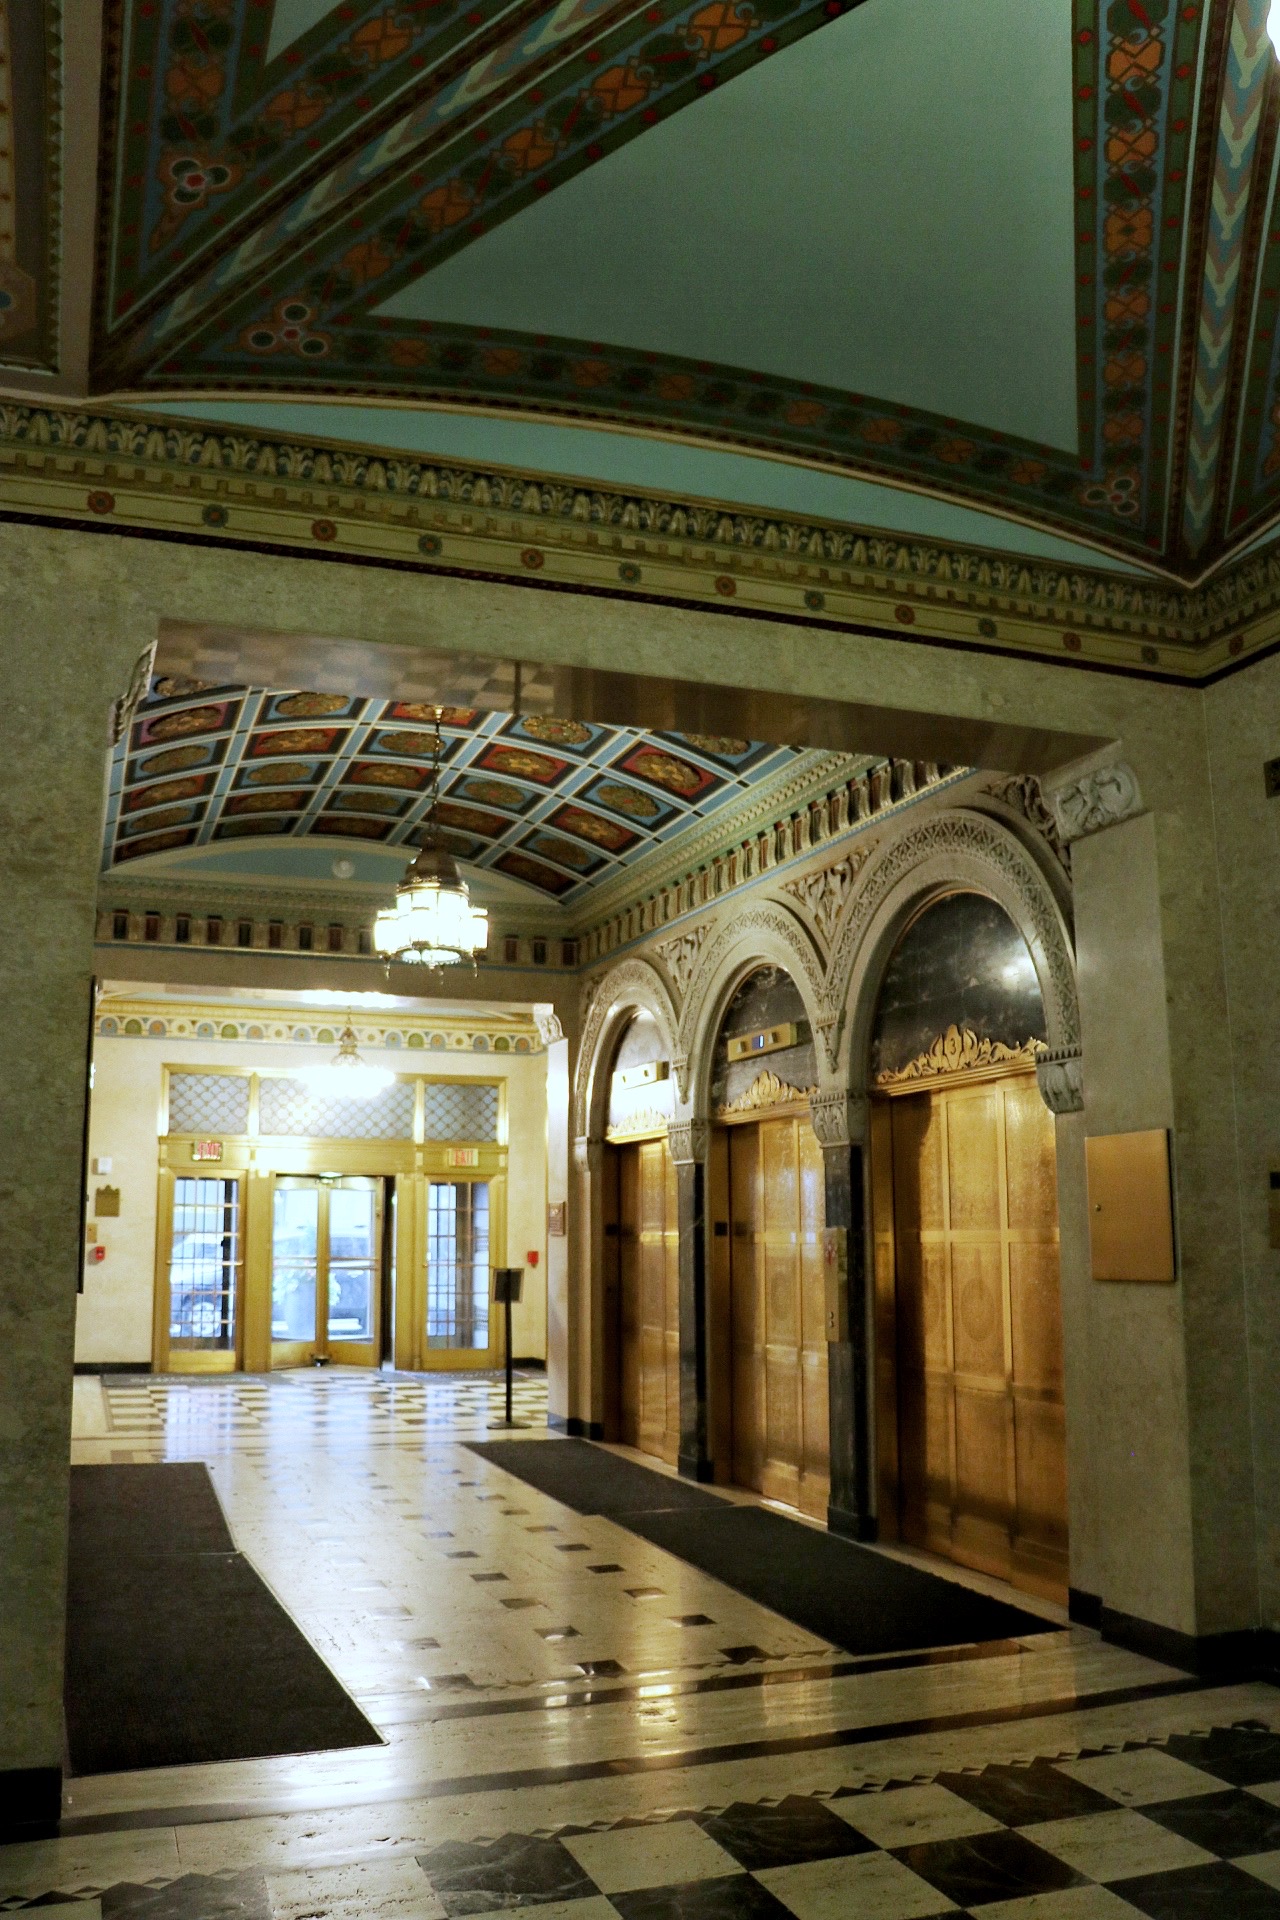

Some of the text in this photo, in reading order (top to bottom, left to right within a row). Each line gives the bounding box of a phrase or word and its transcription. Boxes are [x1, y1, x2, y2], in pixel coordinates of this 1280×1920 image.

[950, 1037, 957, 1055] 3
[198, 1142, 221, 1158] EXIT
[454, 1149, 474, 1166] EXIT
